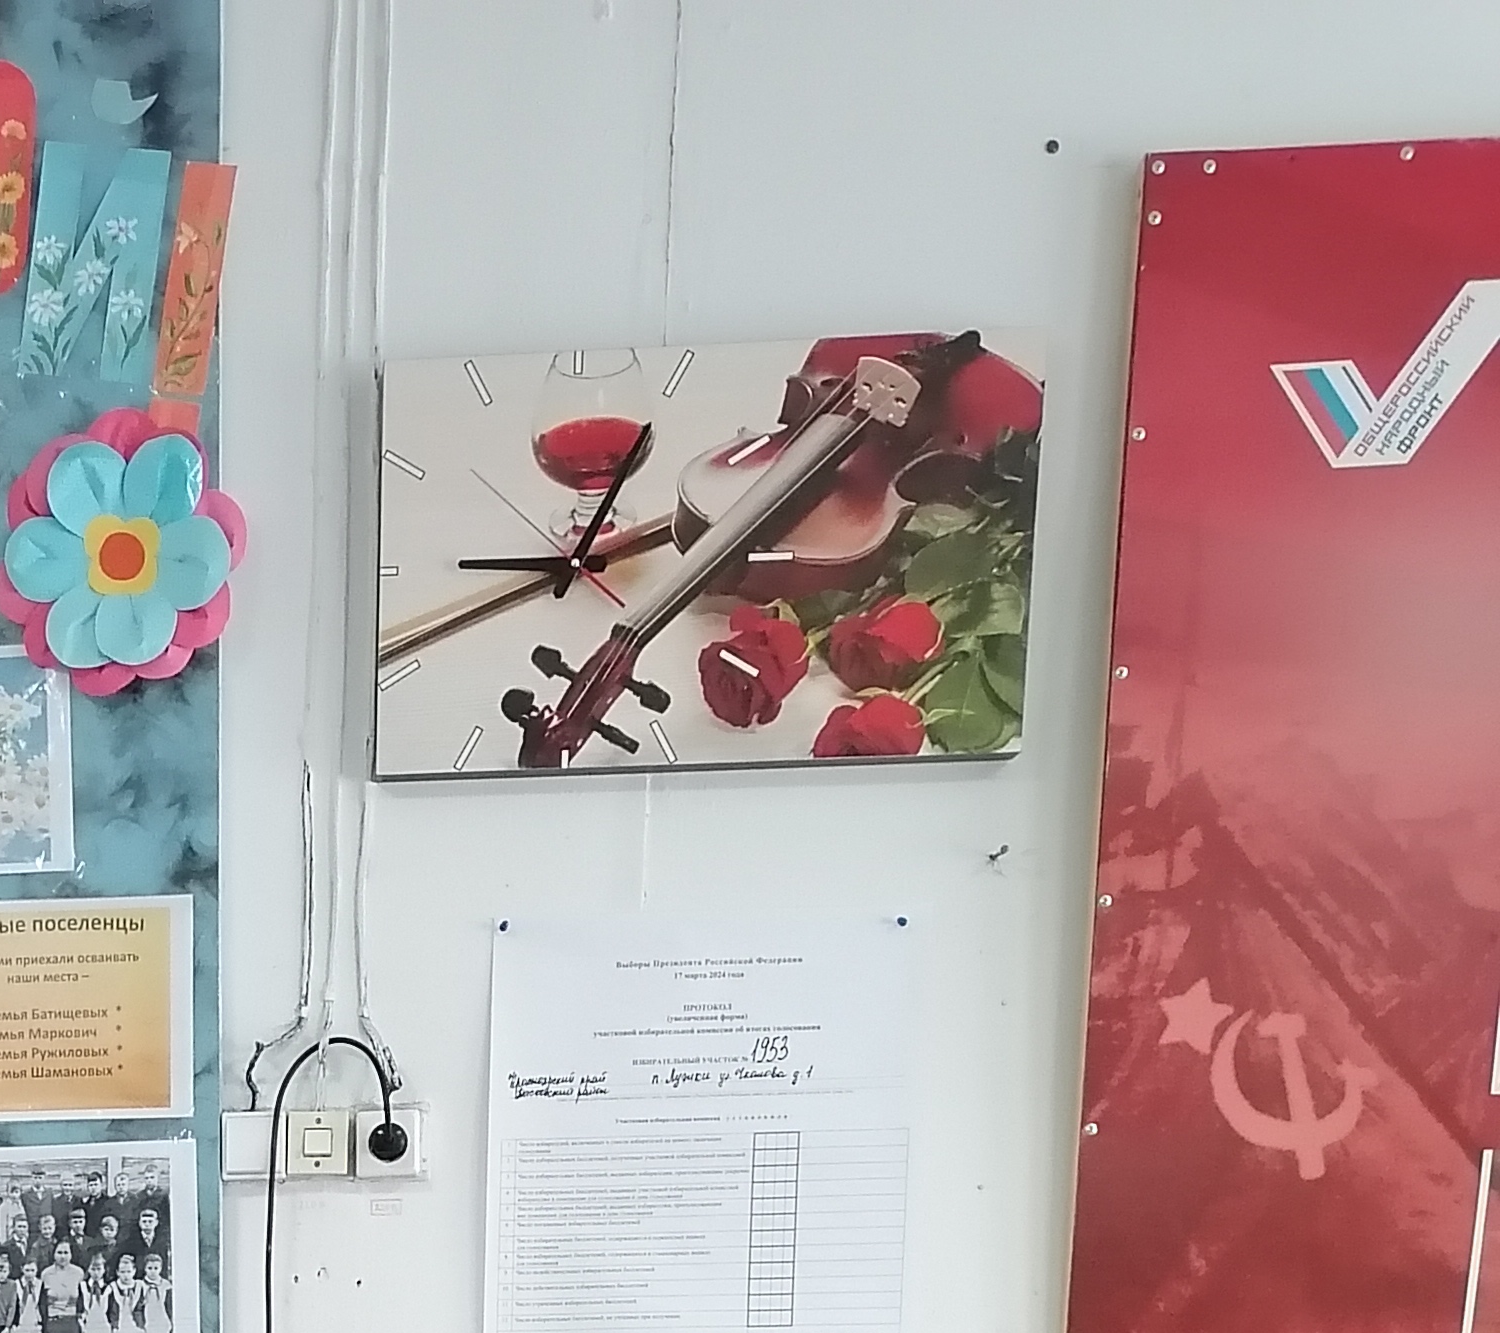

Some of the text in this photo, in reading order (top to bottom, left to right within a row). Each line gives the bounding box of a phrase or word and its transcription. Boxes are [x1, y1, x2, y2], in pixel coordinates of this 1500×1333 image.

[1353, 295, 1475, 458] ОБЩЕРОССИЙСКИЙ
[1375, 358, 1451, 456] НАРОДНЫЙ
[1396, 392, 1444, 455] ФРОНТ
[32, 914, 145, 936] поселенцы
[15, 953, 74, 968] приехали
[77, 951, 140, 965] осваивать
[615, 956, 804, 970] Выборы Президента Российской Федерации
[7, 973, 40, 985] наши
[43, 971, 79, 983] места
[673, 971, 745, 981] 17 марта 2024 года
[31, 1006, 108, 1022] Батищевых
[683, 1003, 732, 1012] ПРОТОКОЛ
[666, 1013, 748, 1024] (увеличенная форма)
[28, 1026, 97, 1042] Маркович
[31, 1046, 109, 1062] Ружиловых
[632, 1056, 701, 1066] ИЗБИРАТЕЛЬНЫЙ
[702, 1056, 739, 1065] УЧАСТОК
[750, 1034, 789, 1064] 1953
[31, 1064, 113, 1079] Шамановых
